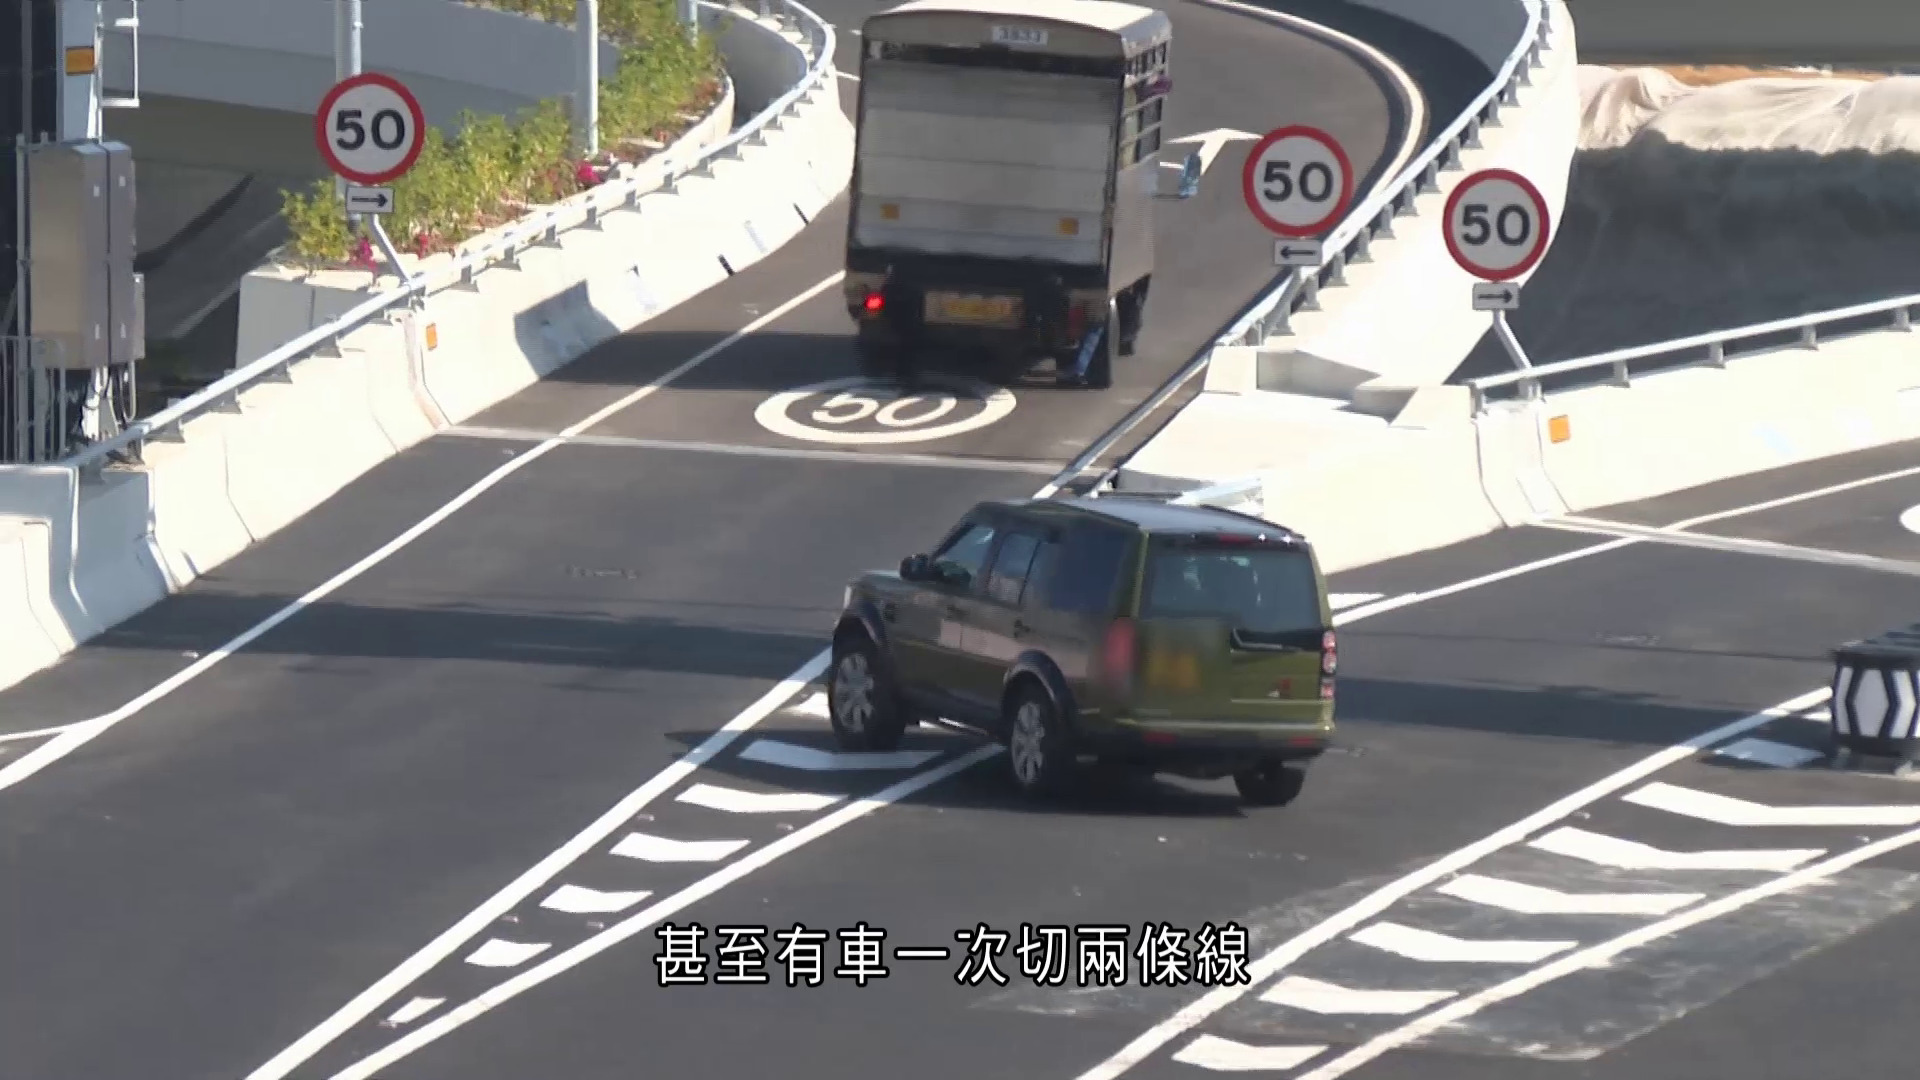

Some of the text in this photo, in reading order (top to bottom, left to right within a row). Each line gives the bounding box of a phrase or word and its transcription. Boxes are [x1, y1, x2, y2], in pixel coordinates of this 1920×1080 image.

[336, 109, 405, 149] 50
[1263, 161, 1334, 202] 50
[1462, 203, 1530, 246] 50
[812, 391, 956, 427] 50
